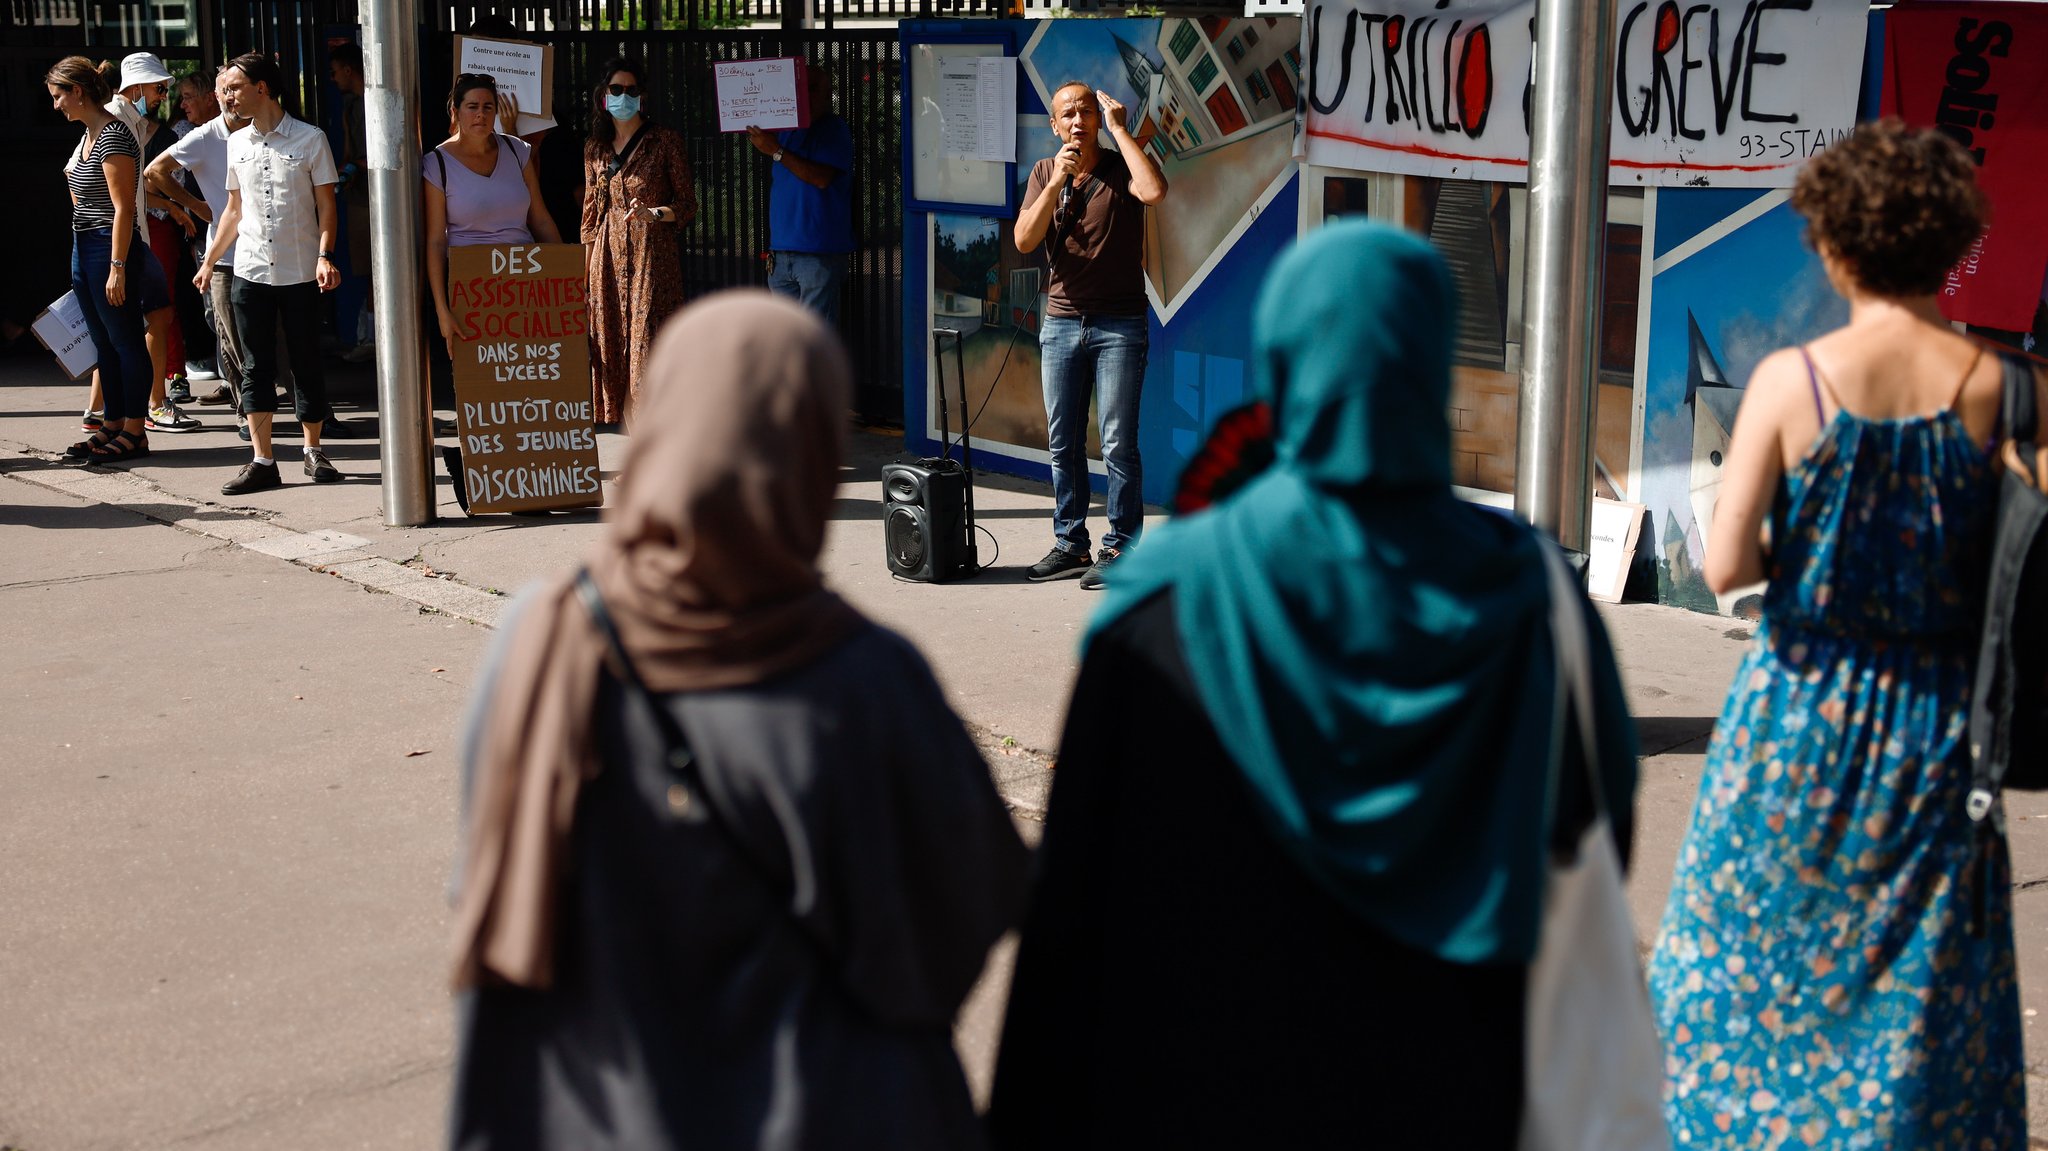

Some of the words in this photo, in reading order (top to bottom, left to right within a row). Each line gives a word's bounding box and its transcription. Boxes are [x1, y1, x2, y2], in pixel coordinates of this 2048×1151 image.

[473, 46, 493, 55] Contre
[505, 49, 522, 58] école
[467, 63, 486, 71] rabais
[496, 66, 529, 76] discrimine
[1309, 2, 1494, 140] UTRILLO
[1616, 0, 1813, 141] GREVE
[731, 97, 758, 107] RESPECT
[731, 109, 758, 118] RESPECT
[491, 246, 543, 275] DES
[462, 309, 587, 342] SOCIALES
[61, 342, 75, 355] CPE
[73, 337, 82, 346] de
[477, 341, 519, 364] DANS
[525, 342, 562, 361] NOS
[494, 362, 561, 382] LYCÉES
[463, 397, 552, 429] PLUTÔT
[554, 400, 591, 422] QUE
[466, 433, 505, 455] DES
[515, 427, 595, 452] JEUNES
[1590, 535, 1614, 543] condes
